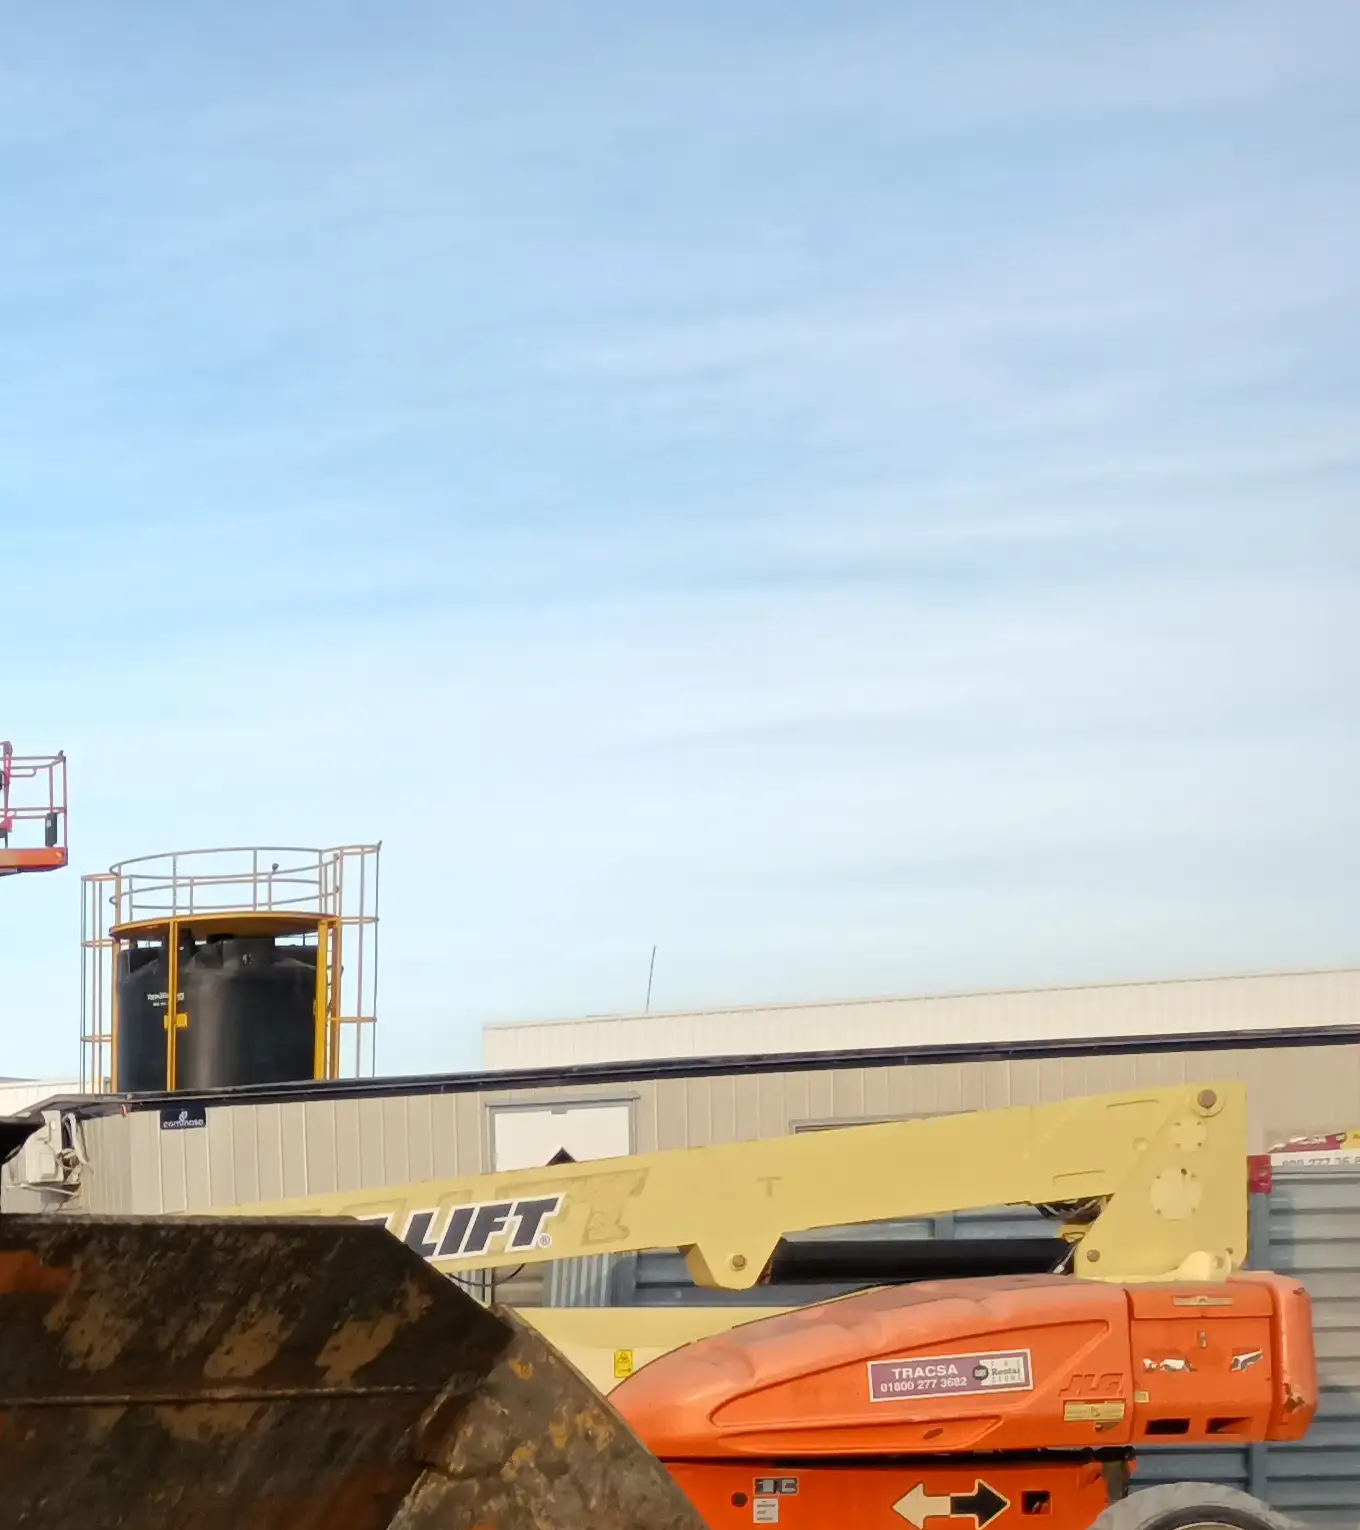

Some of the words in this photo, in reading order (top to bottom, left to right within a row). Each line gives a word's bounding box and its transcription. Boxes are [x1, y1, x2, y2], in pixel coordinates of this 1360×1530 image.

[399, 1193, 566, 1260] LIFT
[891, 1364, 959, 1381] TRACSA
[917, 1378, 938, 1390] 277
